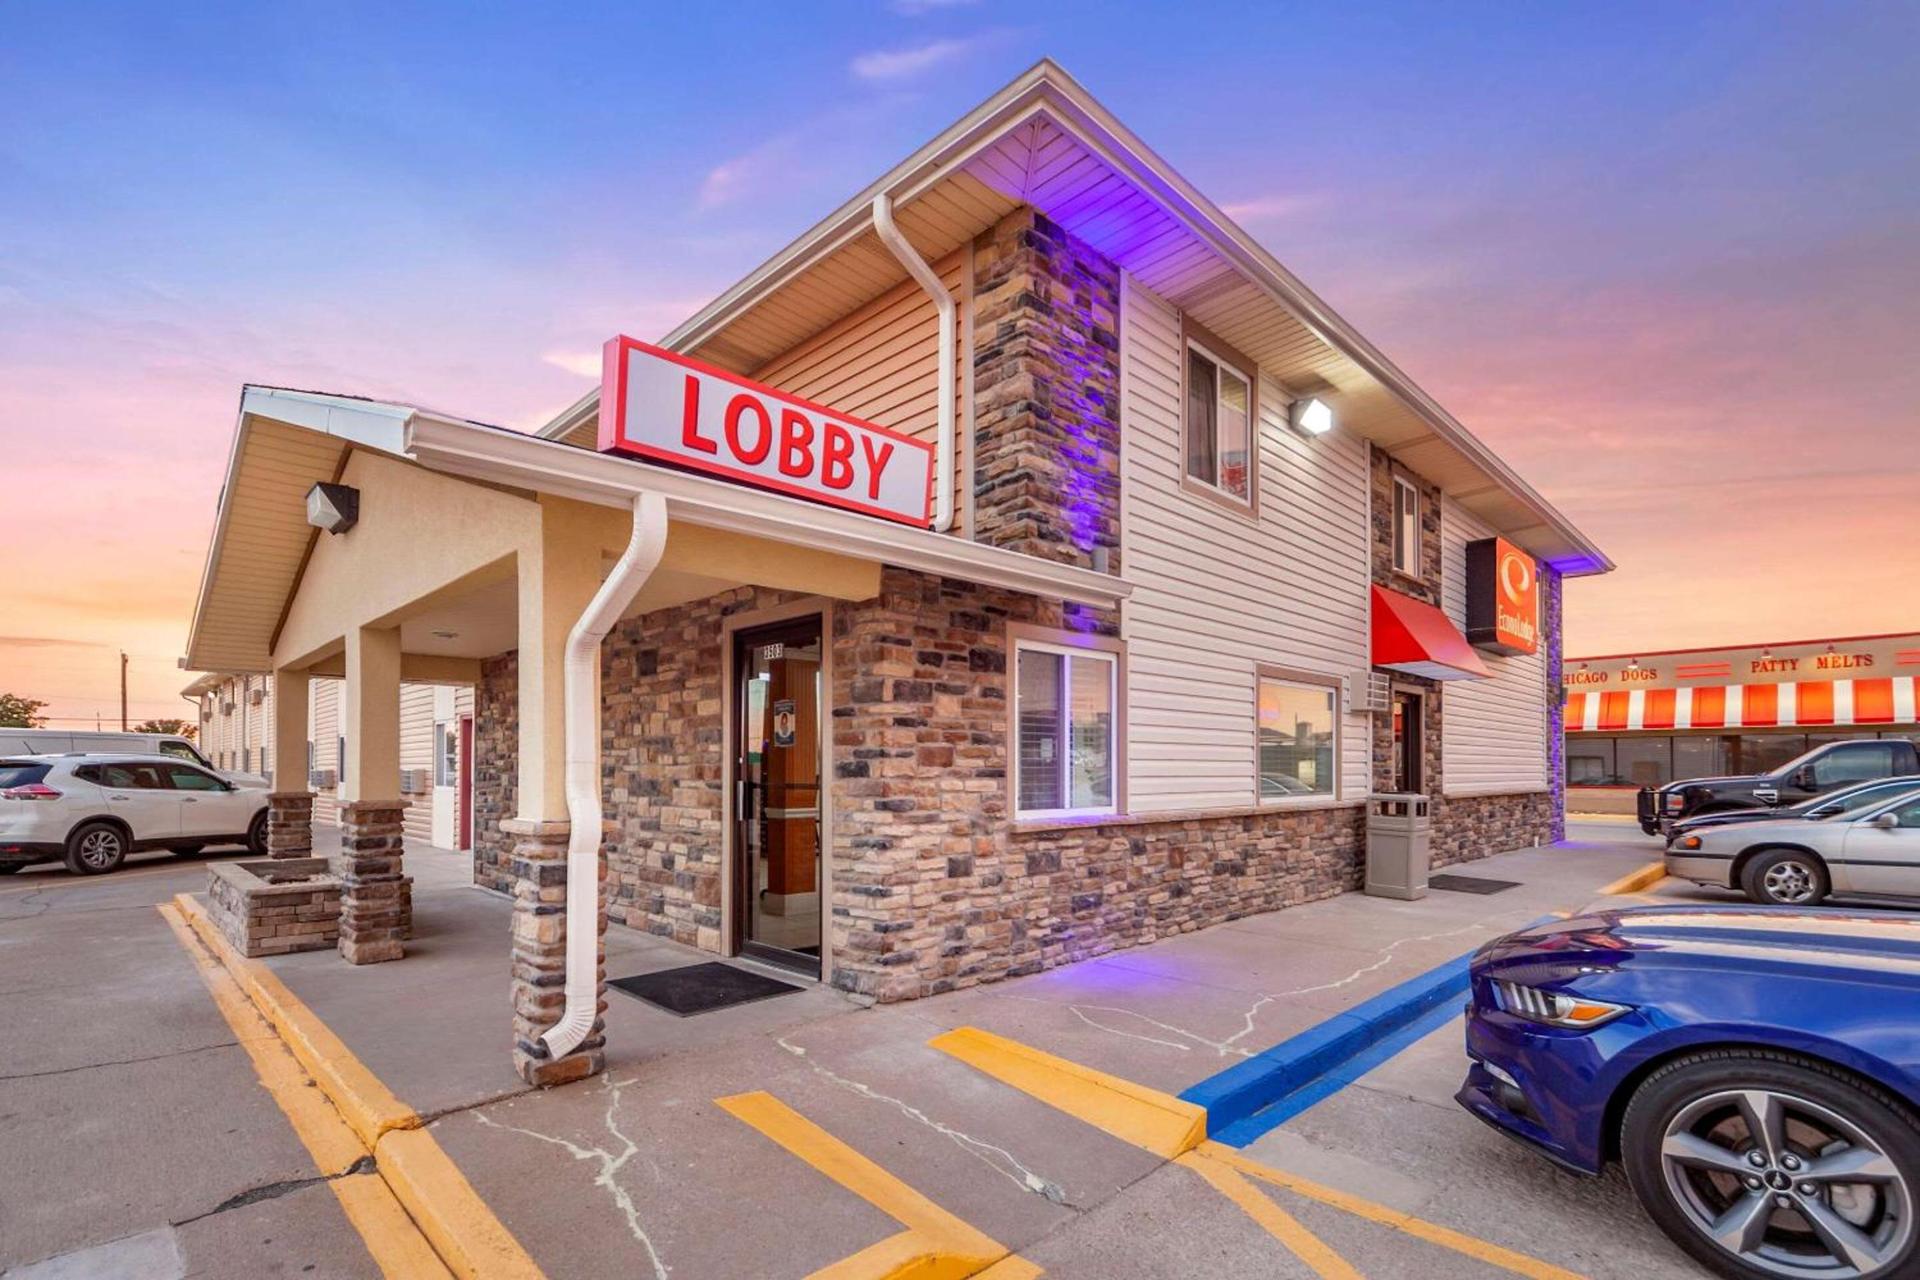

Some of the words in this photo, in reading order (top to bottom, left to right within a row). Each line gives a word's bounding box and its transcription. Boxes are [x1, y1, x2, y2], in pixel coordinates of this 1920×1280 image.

[682, 375, 894, 501] LOBBY
[1751, 658, 1799, 673] PATTY
[1816, 653, 1874, 669] MELTS
[1563, 671, 1608, 685] HICAGO
[1621, 668, 1658, 682] DOGS
